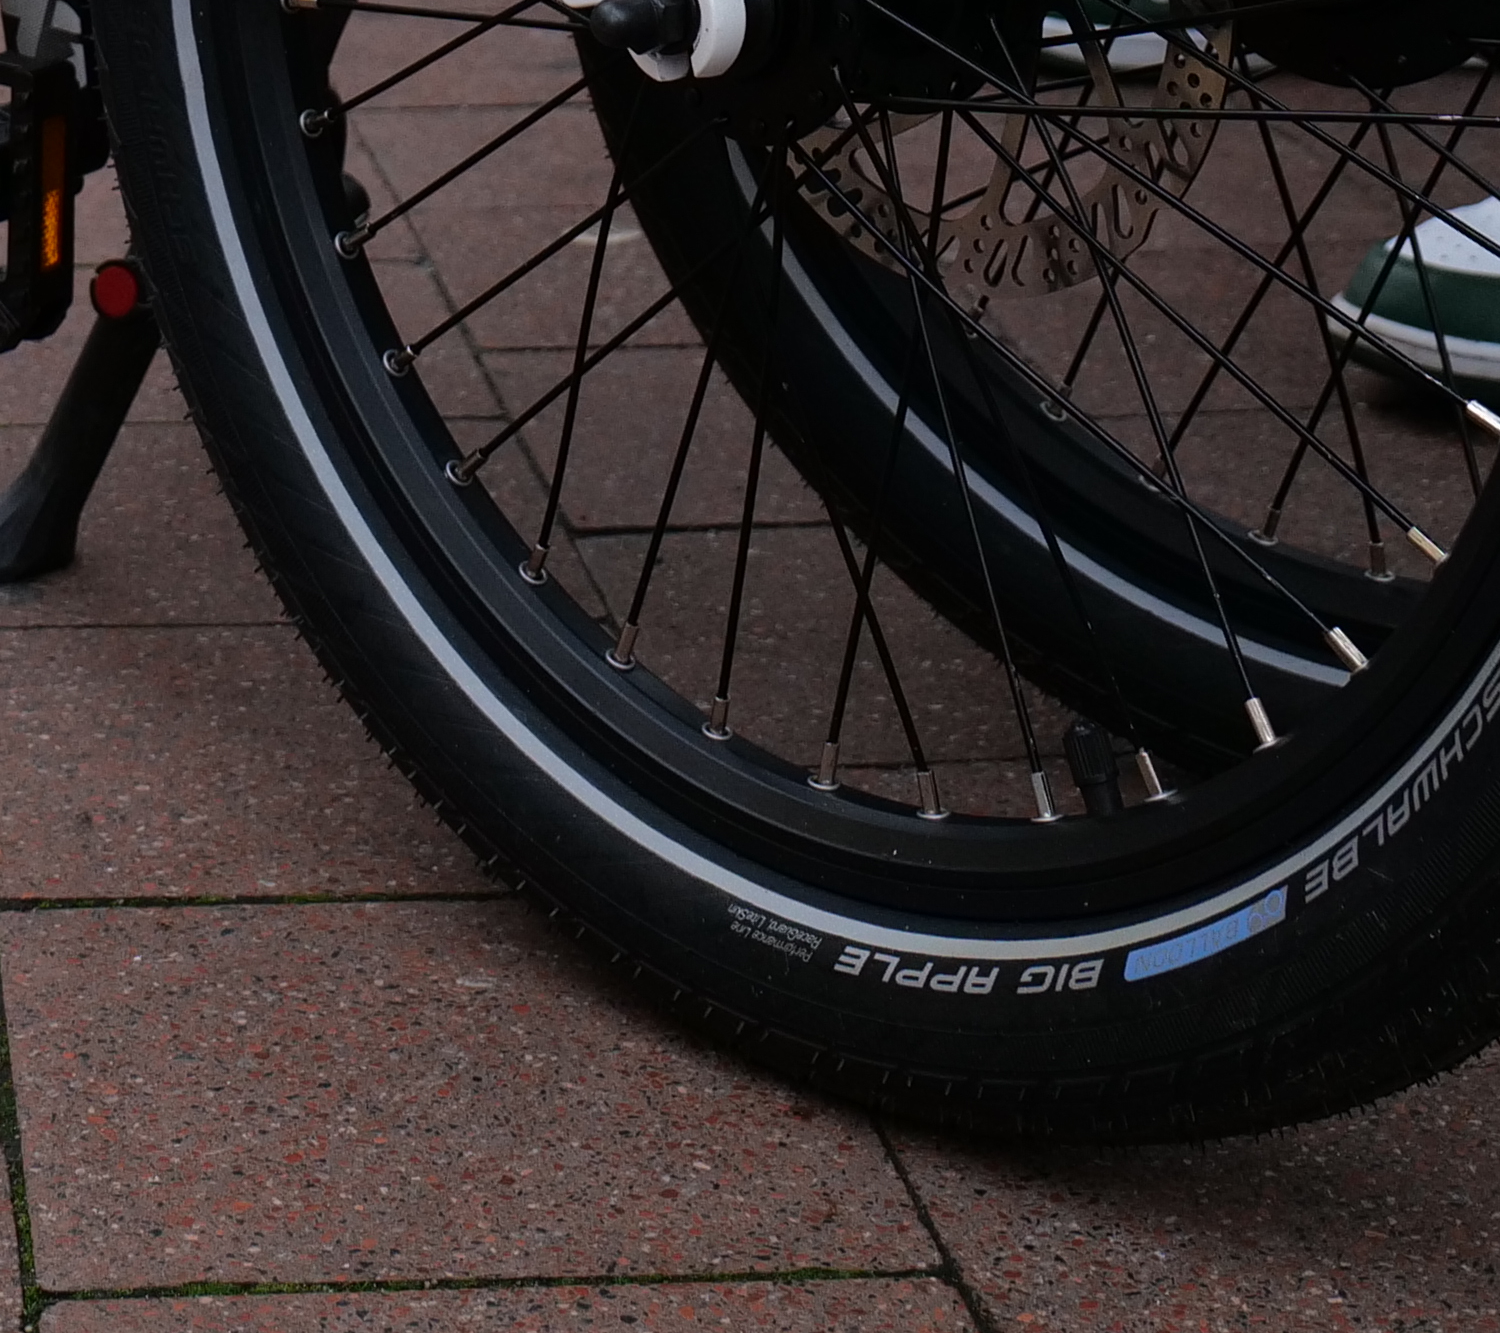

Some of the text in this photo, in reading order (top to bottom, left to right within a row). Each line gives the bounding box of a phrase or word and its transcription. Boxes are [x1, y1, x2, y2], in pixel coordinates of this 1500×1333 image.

[729, 920, 814, 963] Performance Line
[1133, 917, 1240, 974] BALLOON
[833, 945, 1105, 996] BIG APPLE
